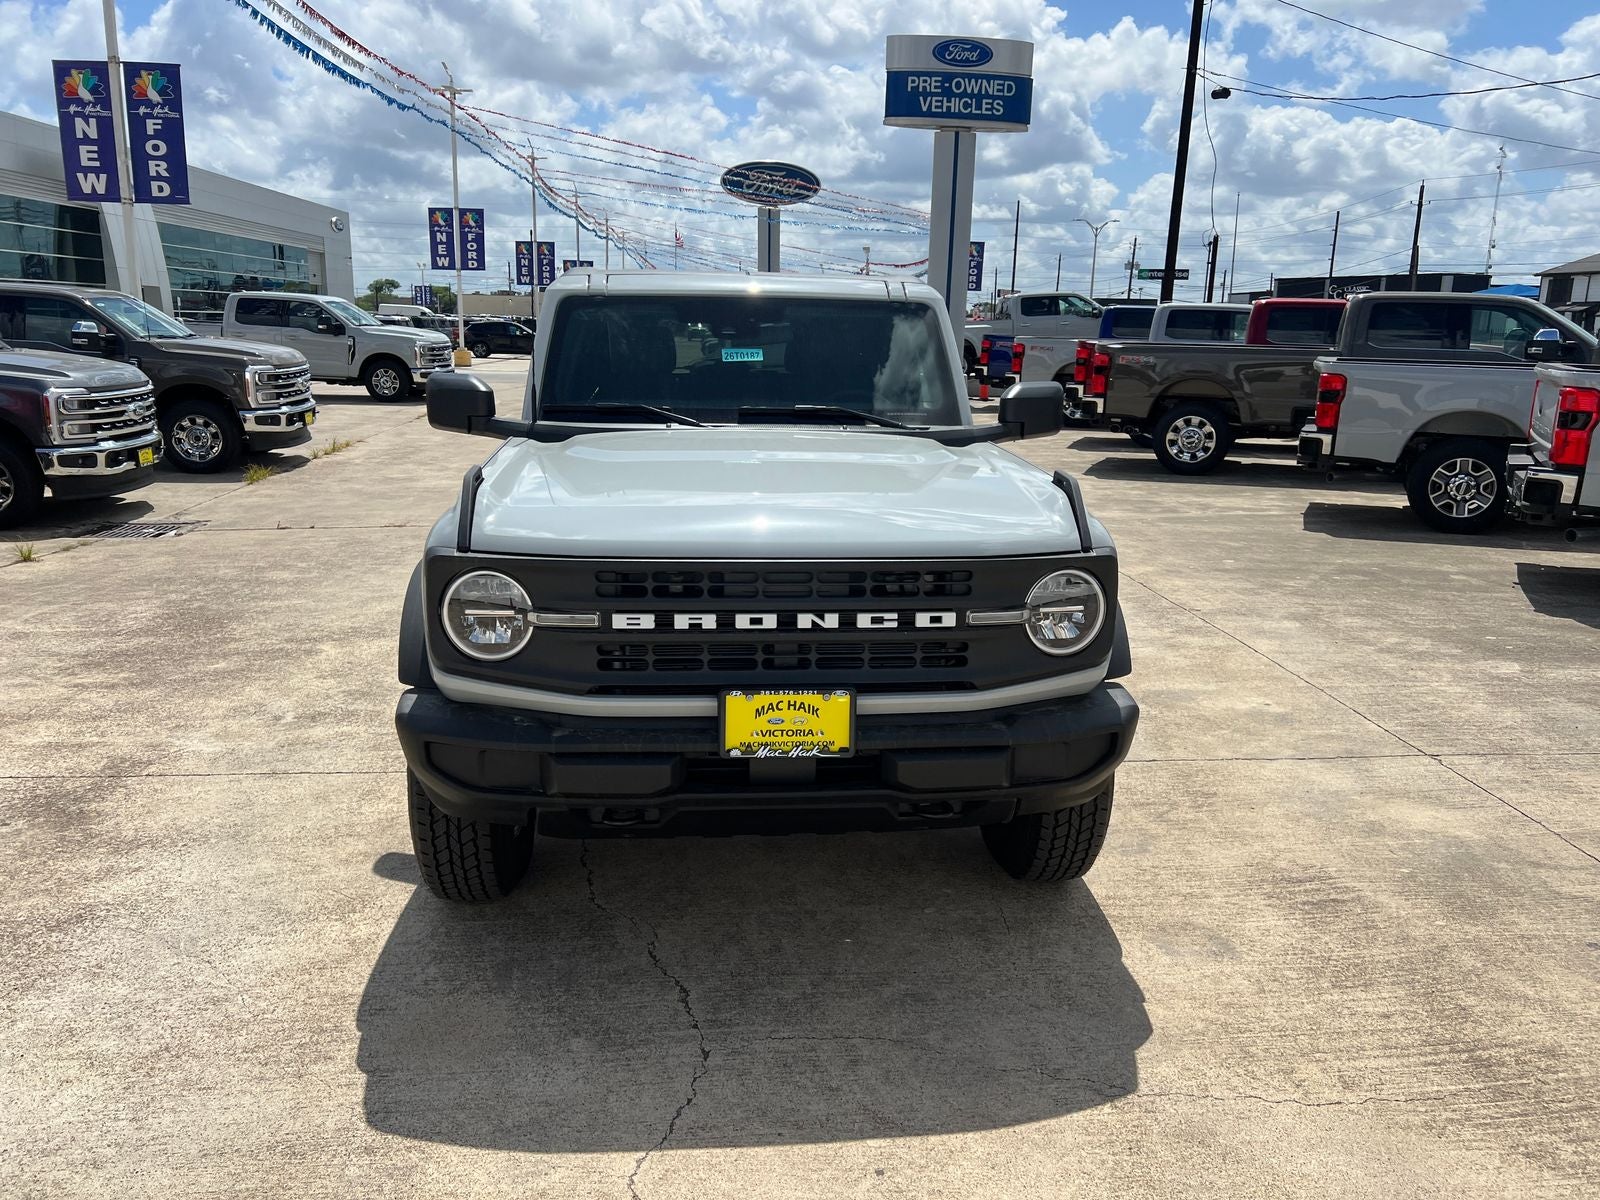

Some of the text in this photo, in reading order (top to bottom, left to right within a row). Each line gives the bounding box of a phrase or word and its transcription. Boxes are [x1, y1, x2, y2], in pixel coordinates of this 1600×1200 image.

[944, 43, 980, 61] Ford
[919, 96, 1004, 116] VEHICLES
[74, 117, 107, 195] NEW
[145, 119, 170, 197] FORD
[743, 169, 797, 195] Ford
[436, 232, 450, 267] NEW
[466, 233, 478, 268] FORD
[520, 258, 530, 283] NEW
[542, 259, 550, 284] FORD
[968, 261, 978, 289] FORD
[724, 351, 761, 361] 26T0187
[612, 612, 956, 630] BRONCO
[754, 700, 820, 719] MAC HAIK
[759, 729, 815, 737] VICTORIA
[754, 745, 823, 758] Mac Haik
